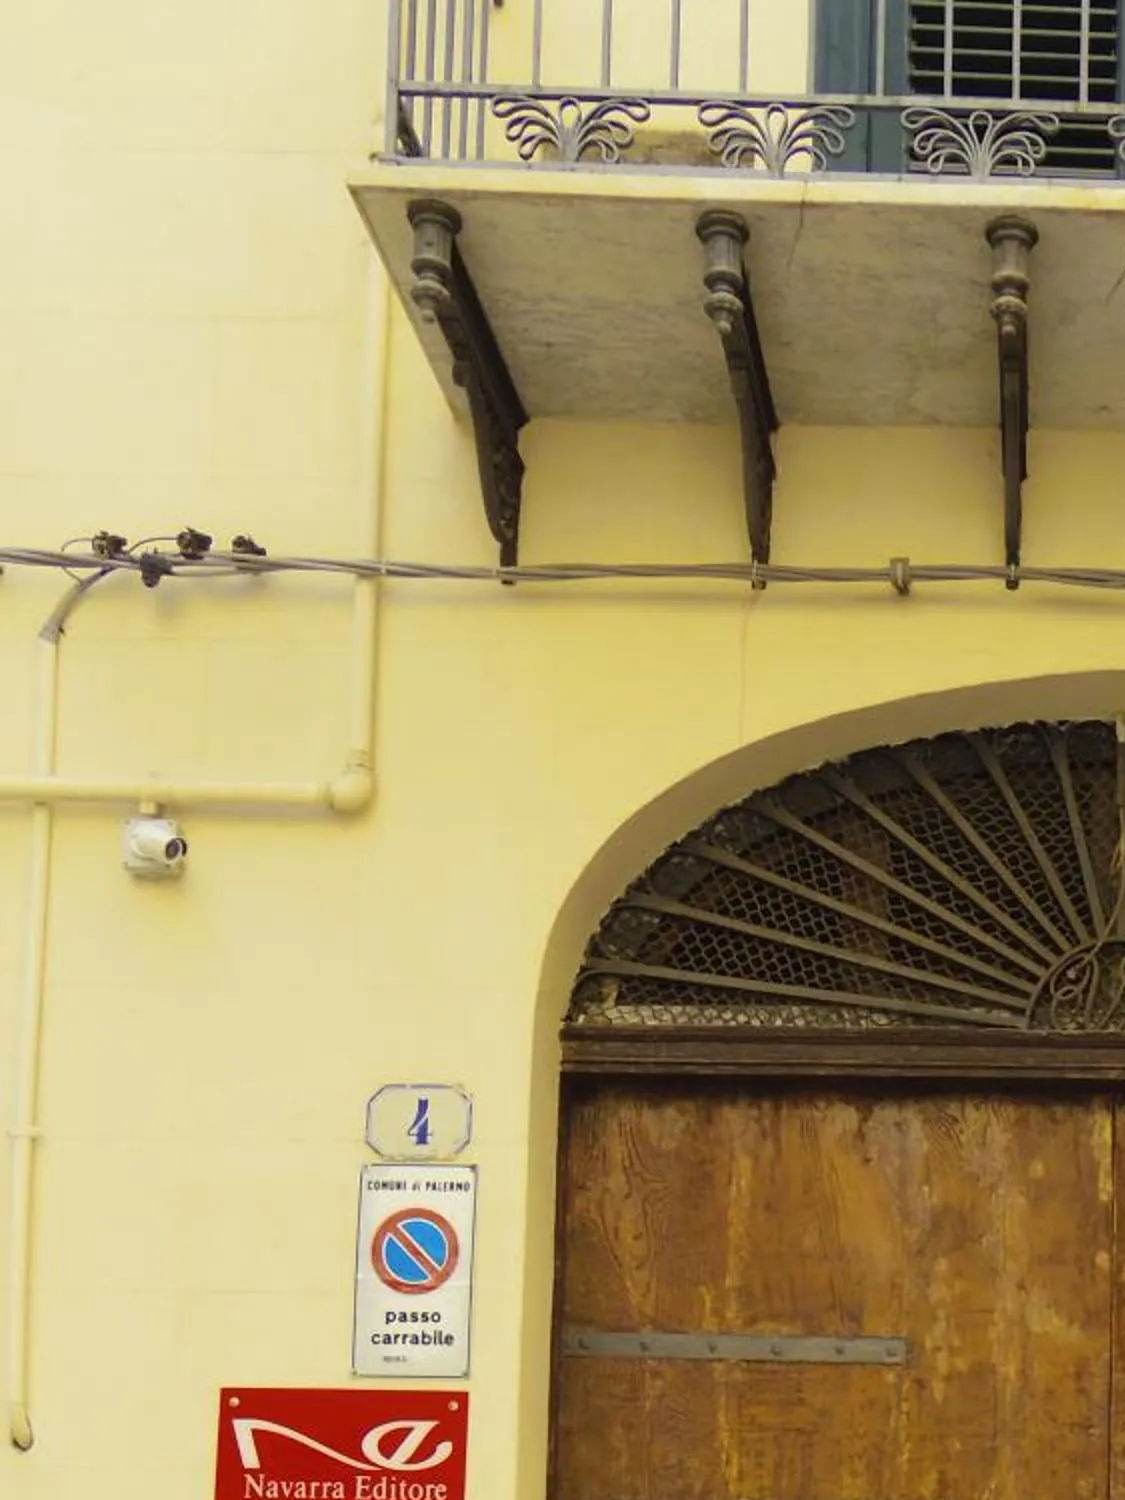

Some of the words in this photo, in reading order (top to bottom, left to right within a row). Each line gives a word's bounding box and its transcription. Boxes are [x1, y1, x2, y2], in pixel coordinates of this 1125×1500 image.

[407, 1097, 433, 1145] 4
[425, 1181, 471, 1193] PALERMO
[385, 1310, 441, 1325] passo
[370, 1329, 455, 1346] carrabile
[243, 1474, 345, 1500] Navarra
